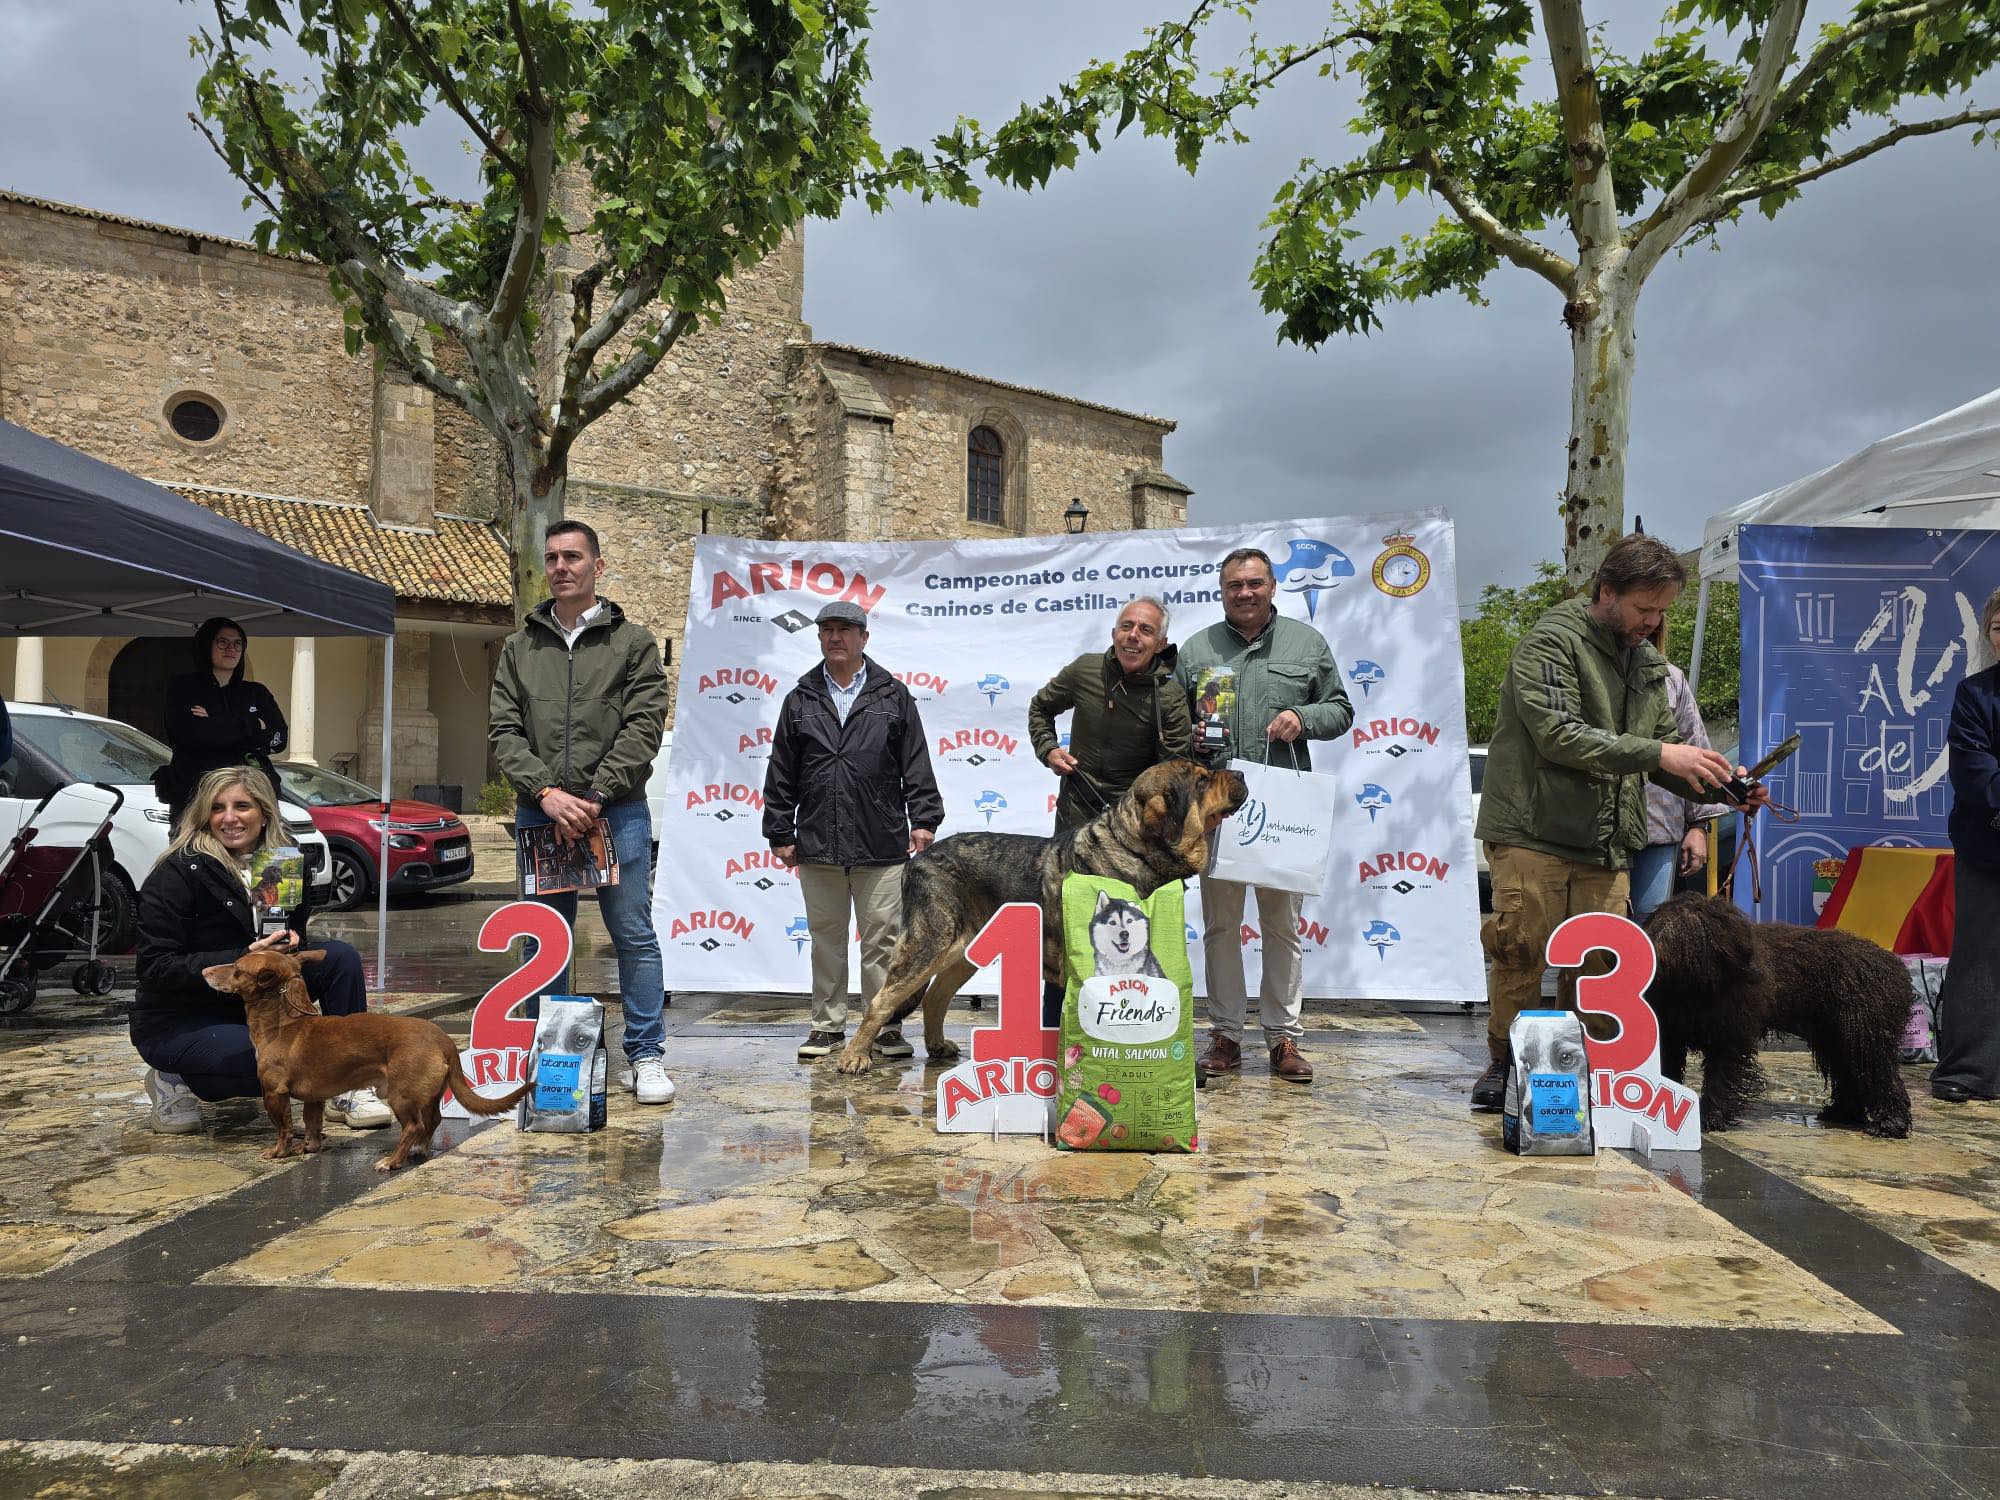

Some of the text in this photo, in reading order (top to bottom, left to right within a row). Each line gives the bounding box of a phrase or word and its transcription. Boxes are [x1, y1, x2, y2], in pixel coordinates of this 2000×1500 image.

[711, 559, 887, 614] ARION
[924, 570, 1065, 591] Campeonato
[1071, 566, 1099, 582] de
[905, 590, 1222, 617] Caninos de Castilla- Manc
[733, 615, 762, 623] SINCE
[699, 668, 778, 695] ARION
[892, 671, 949, 695] ION
[938, 728, 1018, 756] ARION
[1352, 717, 1441, 749] ARION
[1859, 720, 1911, 774] de
[686, 782, 765, 811] ARION
[725, 850, 800, 880] ARIO
[1359, 851, 1450, 884] ARION
[671, 909, 756, 940] ARION
[470, 901, 572, 1049] 2
[965, 902, 1060, 1062] 1
[1109, 979, 1149, 997] ARION
[1546, 912, 1659, 1074] 3
[1096, 999, 1172, 1025] Friends
[541, 1058, 580, 1068] titanium
[1091, 1046, 1168, 1060] VITAL SALMON
[541, 1085, 572, 1093] GROWTH
[943, 1060, 1058, 1124] ARIO
[1532, 1078, 1575, 1088] titanium
[1540, 1107, 1574, 1115] GROWTH
[1590, 1072, 1694, 1135] ION
